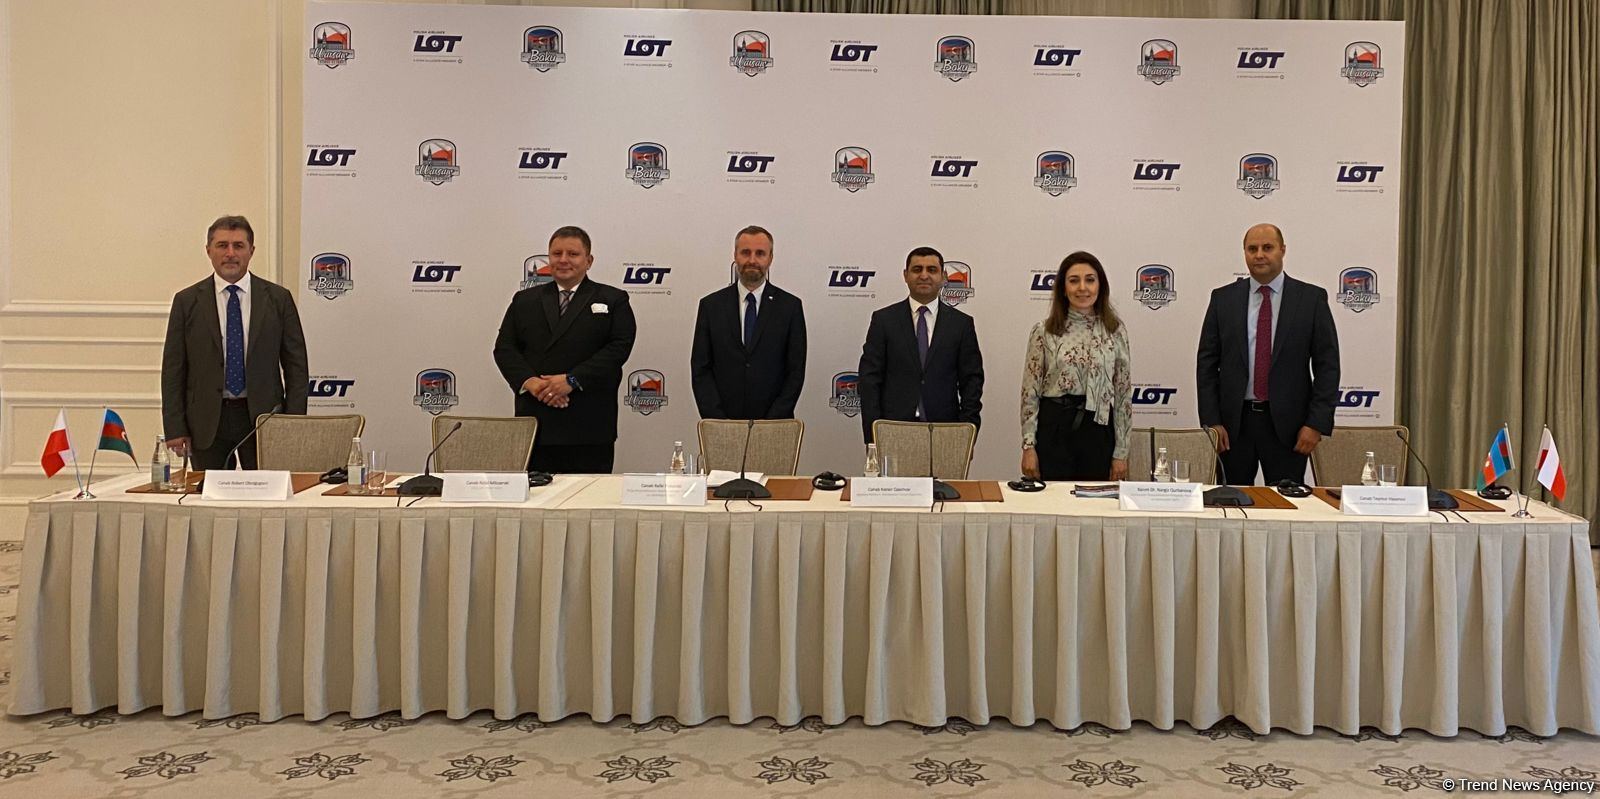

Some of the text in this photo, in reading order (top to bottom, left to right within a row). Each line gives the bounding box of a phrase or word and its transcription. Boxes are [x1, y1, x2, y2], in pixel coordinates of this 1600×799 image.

[414, 35, 462, 52] LOT
[624, 39, 672, 56] LOT
[530, 49, 556, 62] Baku
[831, 45, 878, 61] LOT
[1034, 49, 1081, 66] LOT
[1237, 52, 1284, 68] LOT
[943, 58, 969, 72] Baku
[307, 149, 356, 166] LOT
[519, 152, 567, 169] LOT
[728, 156, 774, 172] LOT
[634, 165, 661, 178] Baku
[931, 160, 978, 177] LOT
[1134, 163, 1180, 180] LOT
[1337, 166, 1384, 182] LOT
[1042, 174, 1068, 187] Baku
[1245, 176, 1271, 189] Baku
[413, 265, 461, 282] LOT
[623, 268, 671, 284] LOT
[829, 270, 875, 287] LOT
[1031, 273, 1055, 290] LO
[317, 276, 344, 289] Baku
[1141, 287, 1167, 299] Baku
[1345, 290, 1371, 302] Baku
[308, 380, 355, 397] LOT
[1132, 387, 1177, 404] LOT
[422, 393, 449, 405] Baku
[1337, 391, 1380, 407] LOT
